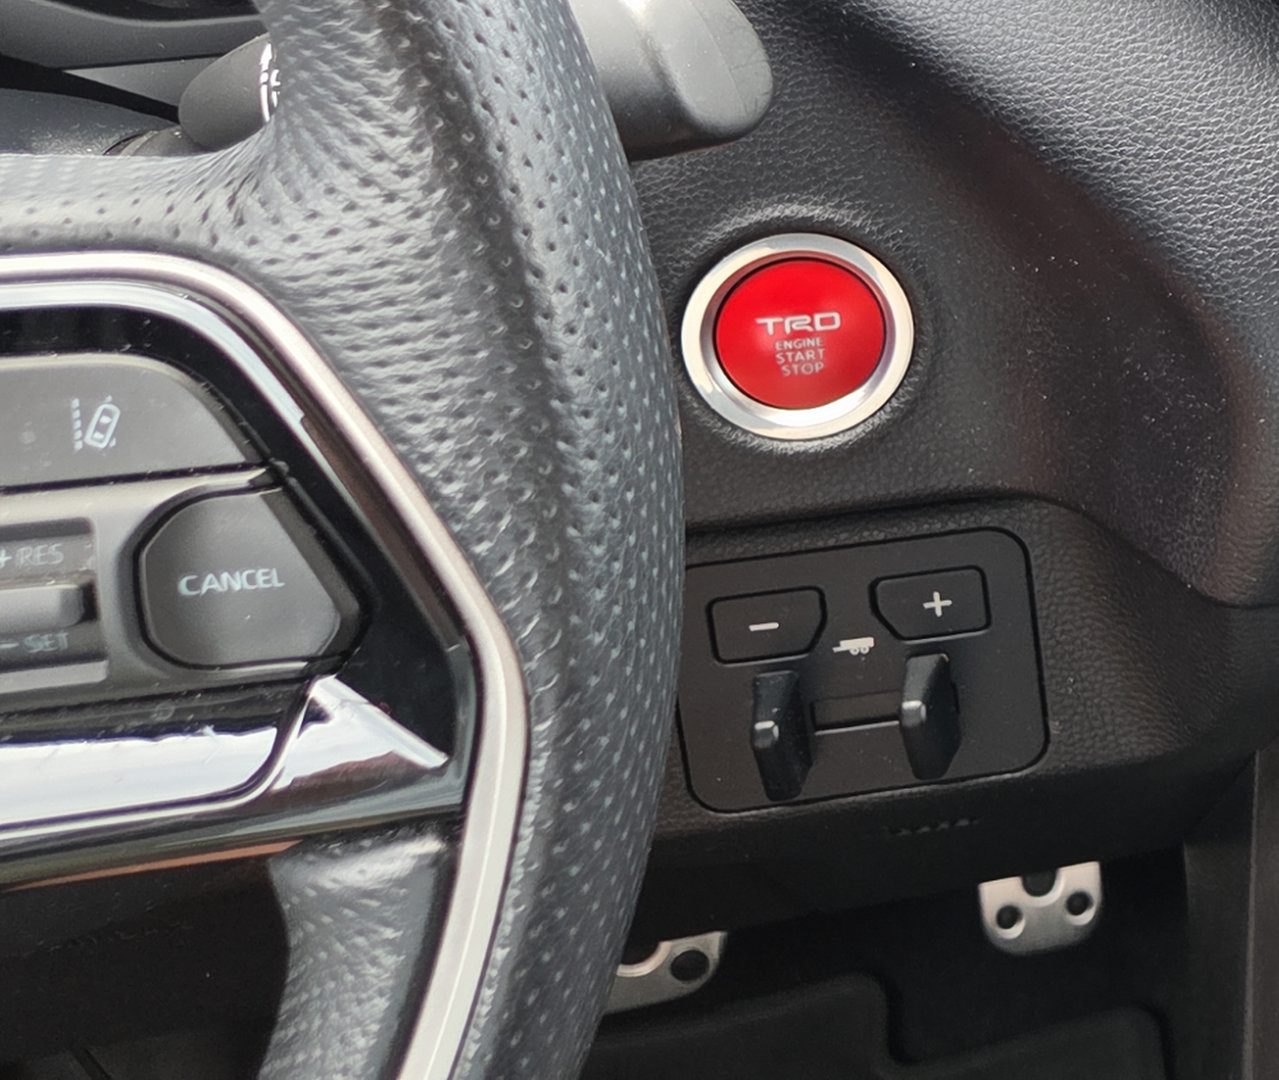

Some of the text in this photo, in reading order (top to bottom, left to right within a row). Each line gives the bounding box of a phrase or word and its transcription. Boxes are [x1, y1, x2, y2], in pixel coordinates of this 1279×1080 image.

[754, 311, 842, 336] TRD
[774, 336, 824, 352] ENGINE
[775, 347, 826, 365] START
[780, 361, 825, 377] STOP
[177, 567, 285, 597] CANCEL
[23, 631, 69, 653] SET
